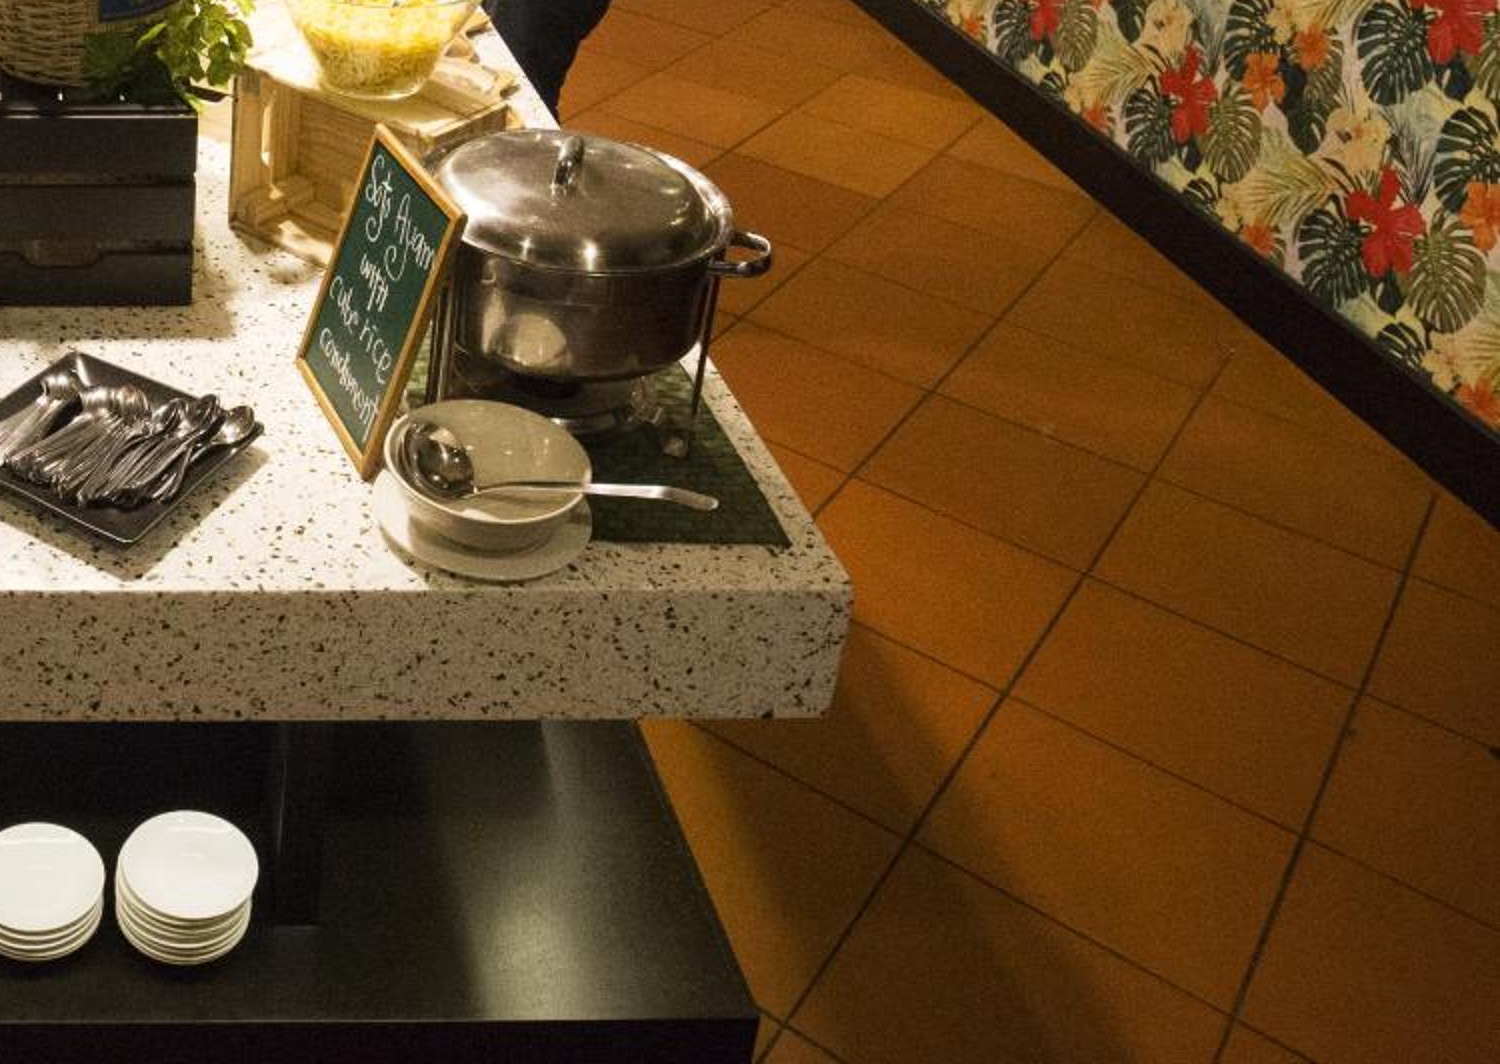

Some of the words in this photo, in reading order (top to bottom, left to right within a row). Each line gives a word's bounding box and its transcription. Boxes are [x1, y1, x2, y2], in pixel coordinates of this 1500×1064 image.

[365, 154, 393, 242] Soto
[384, 193, 435, 281] Ayam
[360, 253, 389, 313] with
[360, 318, 392, 385] rice
